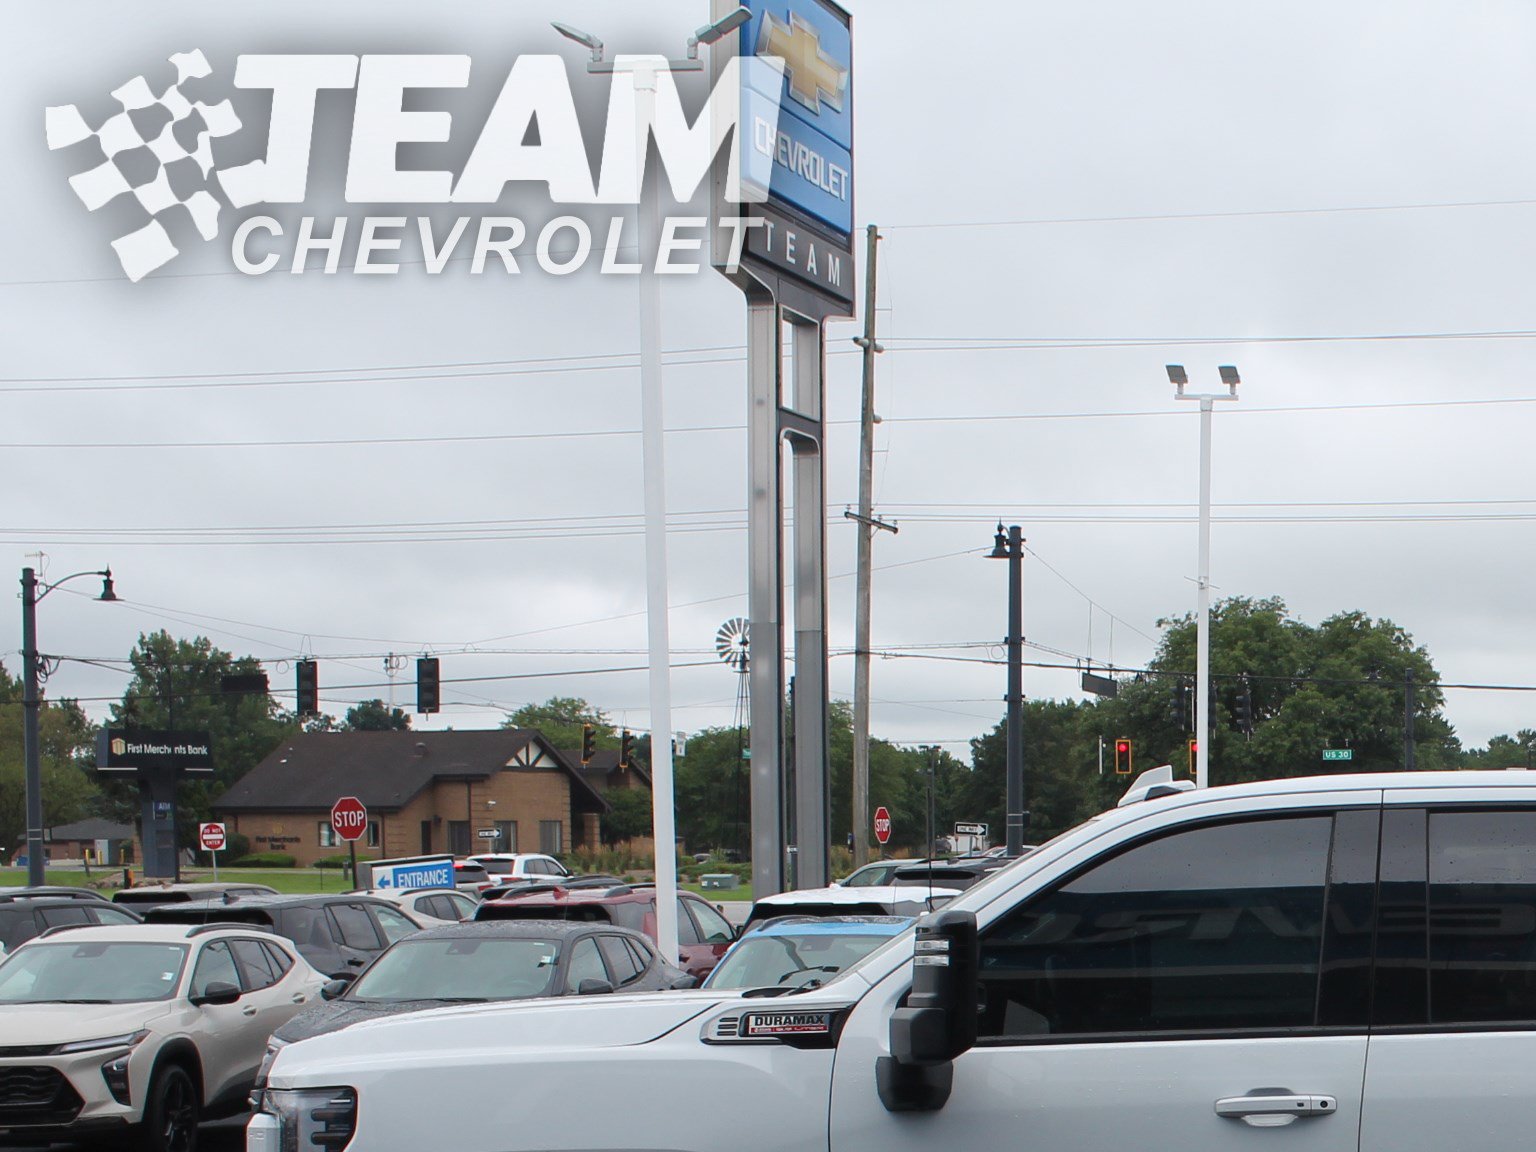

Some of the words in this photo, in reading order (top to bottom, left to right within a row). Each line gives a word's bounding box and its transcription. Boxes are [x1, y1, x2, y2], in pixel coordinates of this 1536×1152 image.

[754, 116, 848, 201] CHEVROLET
[763, 219, 841, 287] TEAM
[127, 743, 143, 754] First
[188, 745, 208, 755] Bank
[334, 810, 364, 828] STOP
[875, 818, 890, 832] STOP
[397, 869, 449, 888] ENTRANCE
[754, 1015, 825, 1026] DURAMAX
